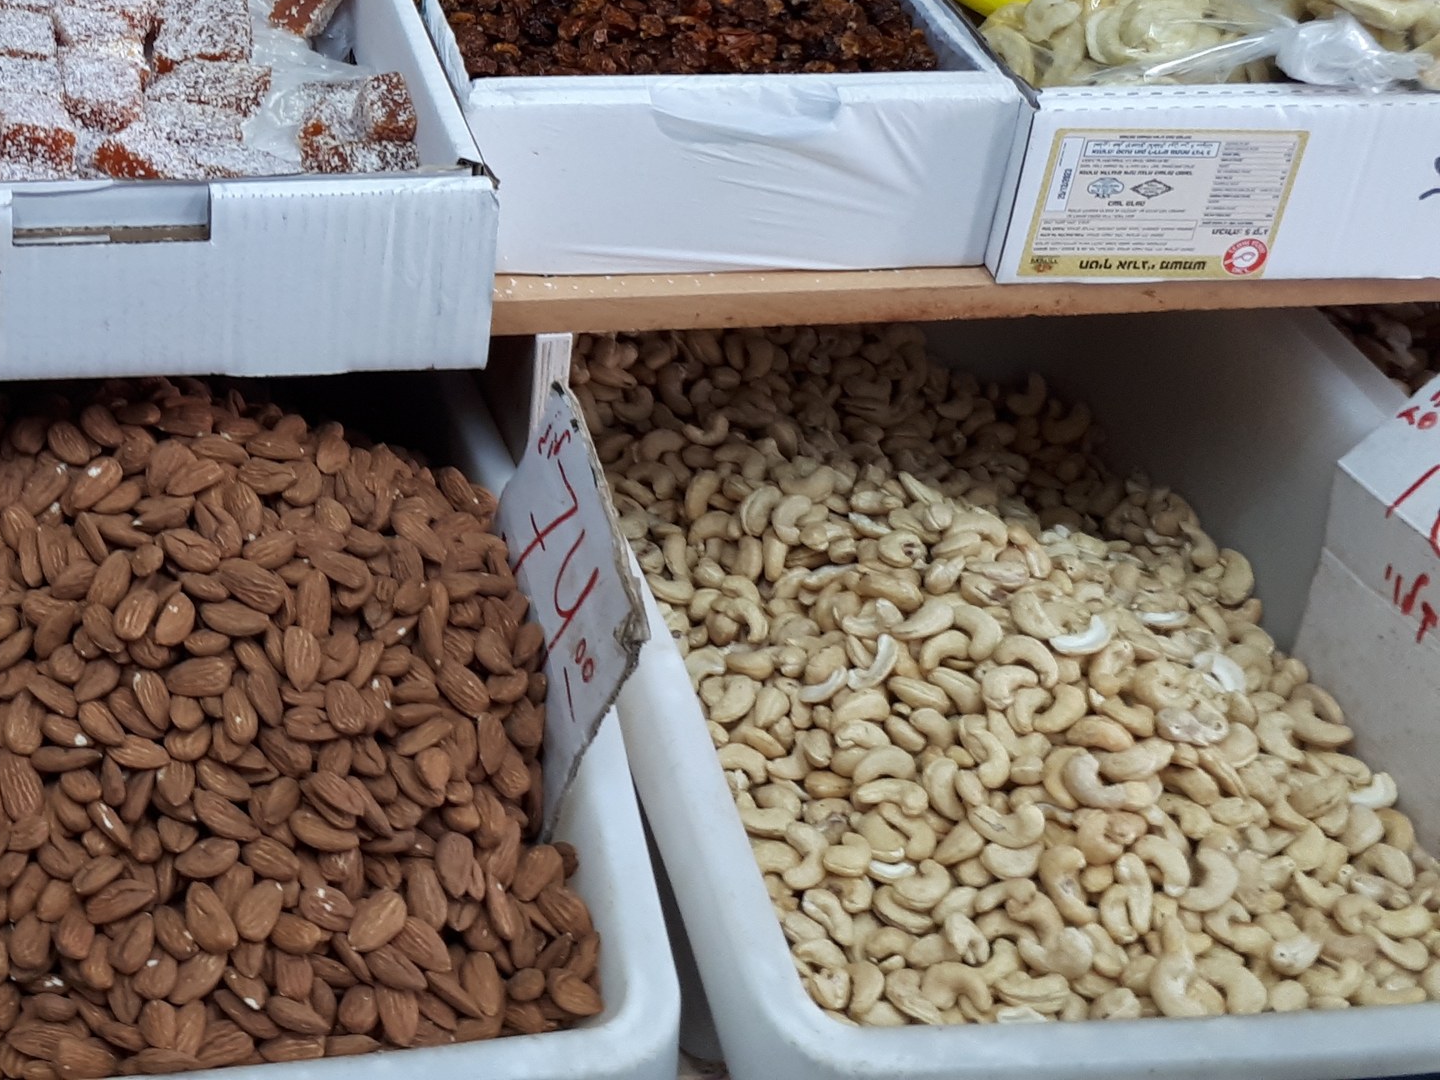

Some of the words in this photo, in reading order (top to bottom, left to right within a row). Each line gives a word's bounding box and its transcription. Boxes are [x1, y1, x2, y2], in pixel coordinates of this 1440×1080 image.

[1079, 259, 1112, 271] חטיף
[1115, 259, 1157, 271] אנרג'י
[1159, 259, 1208, 271] משמש
